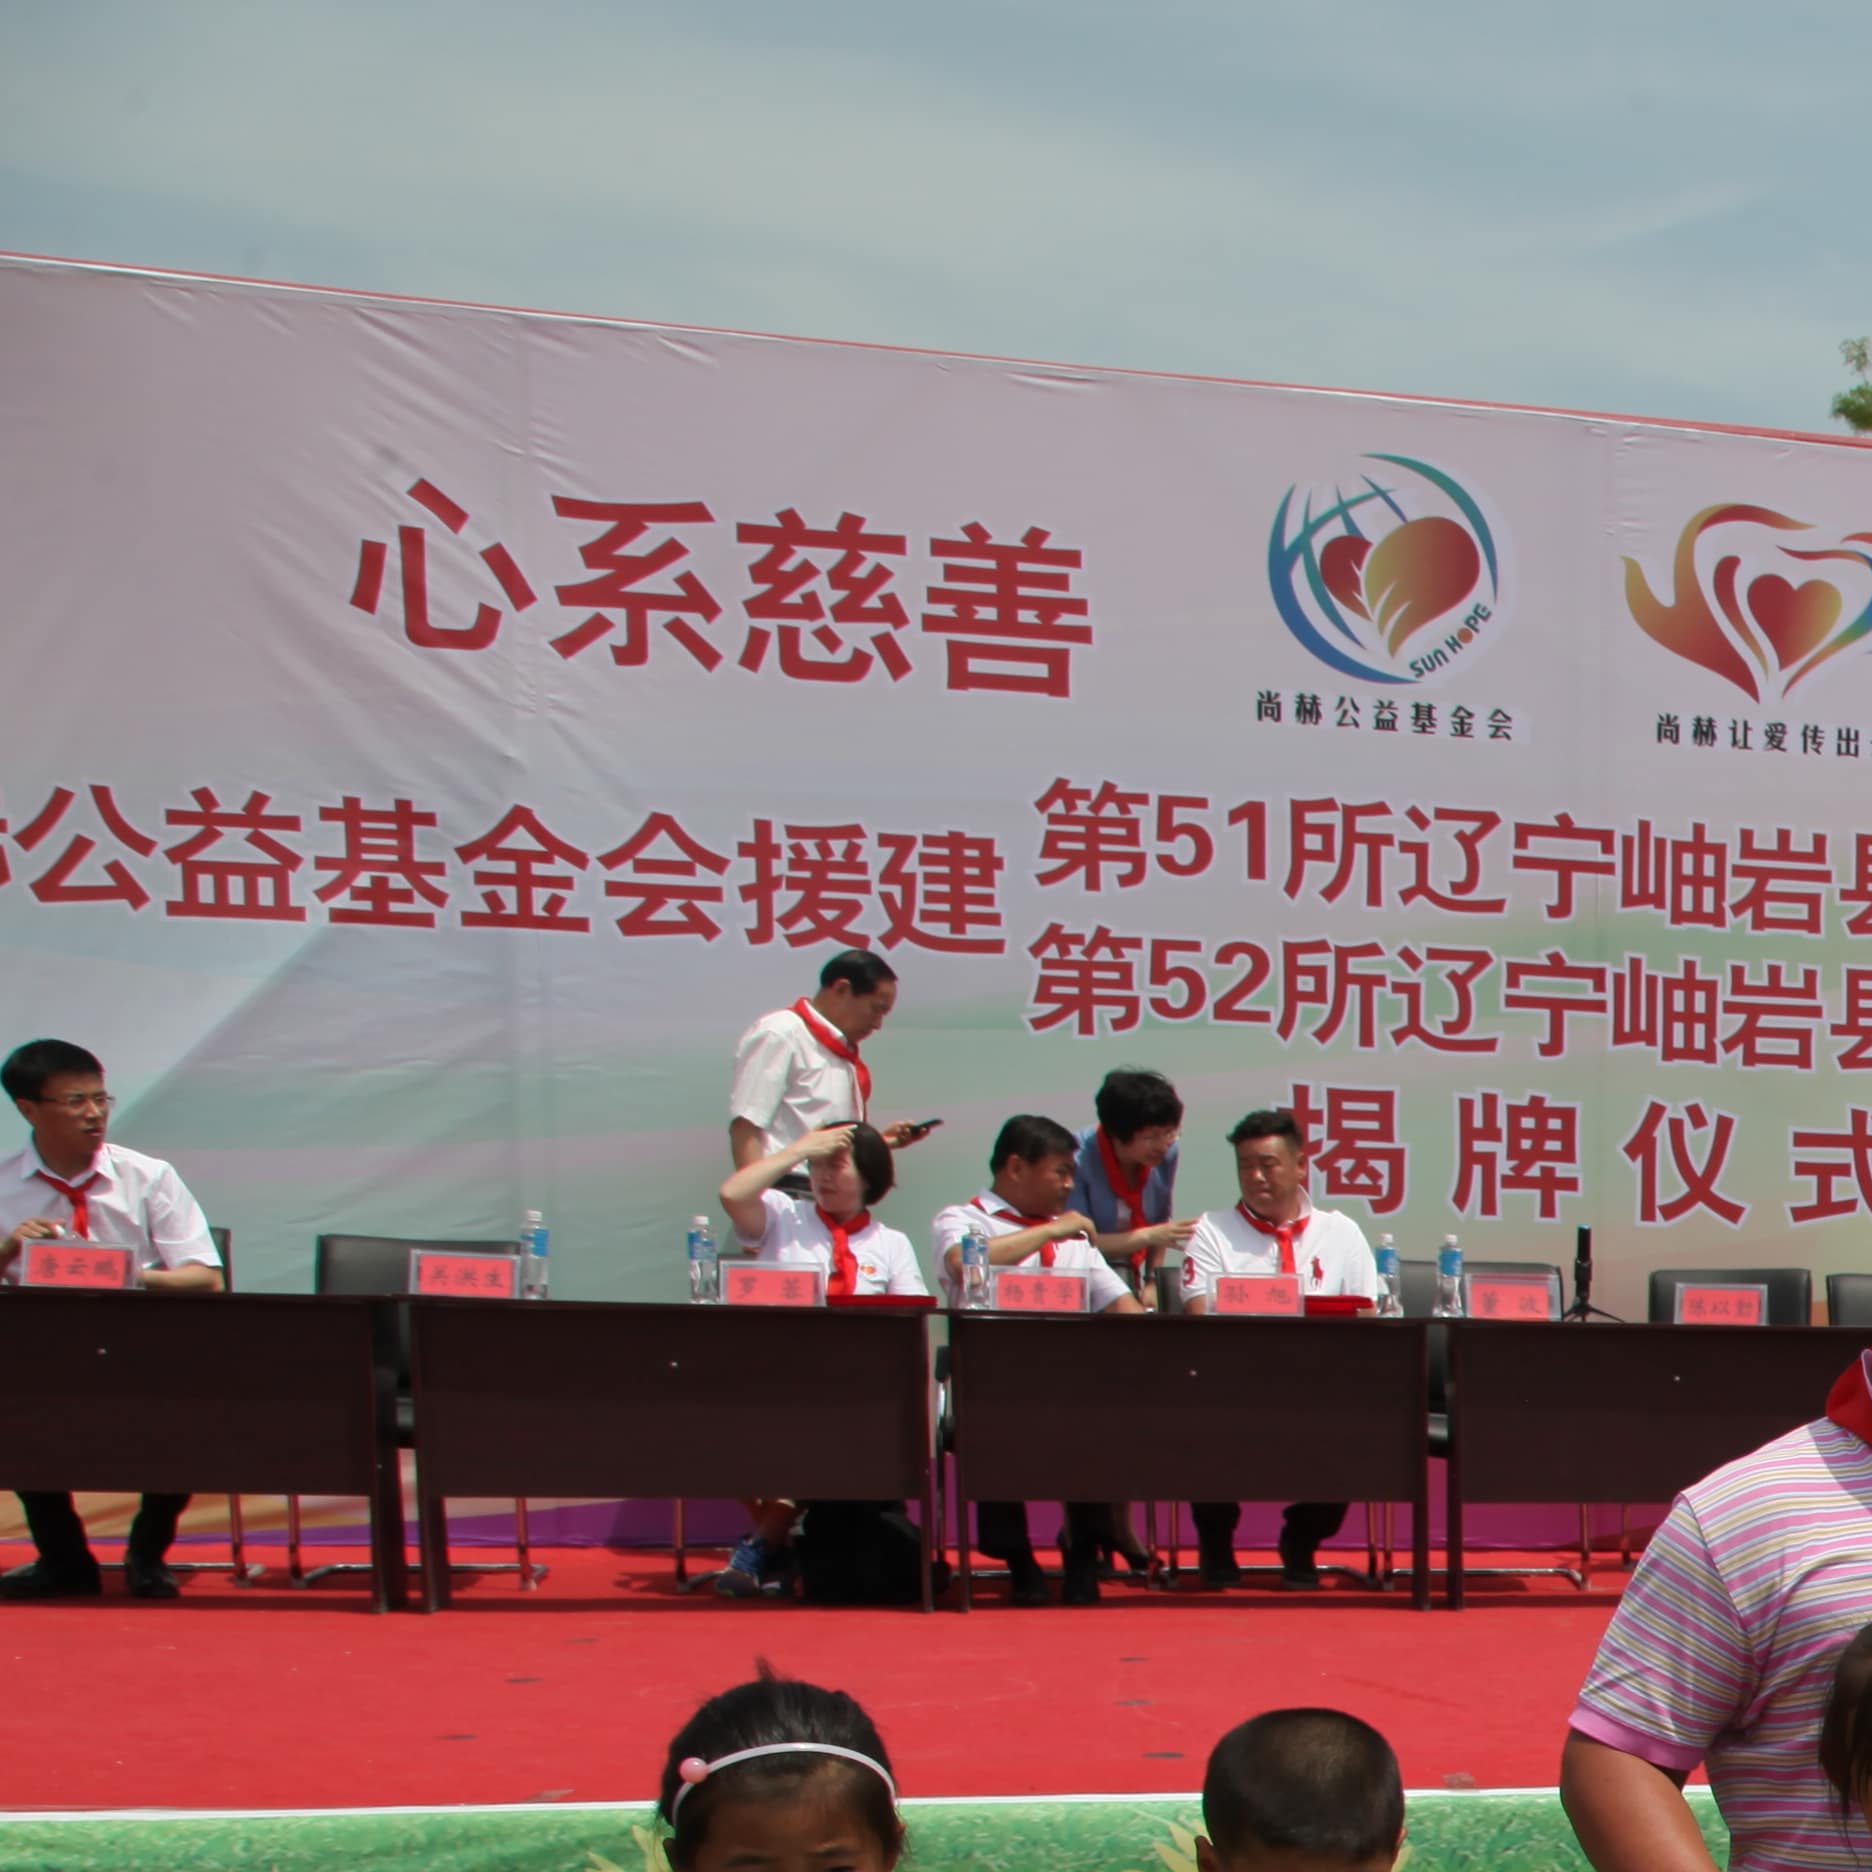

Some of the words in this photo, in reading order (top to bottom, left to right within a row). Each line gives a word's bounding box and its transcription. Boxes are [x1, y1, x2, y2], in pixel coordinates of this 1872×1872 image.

[349, 477, 1094, 699] 心系慈善
[1256, 690, 1512, 741] 尚赫公益基金会
[0, 781, 1006, 955] 公益基金会援建
